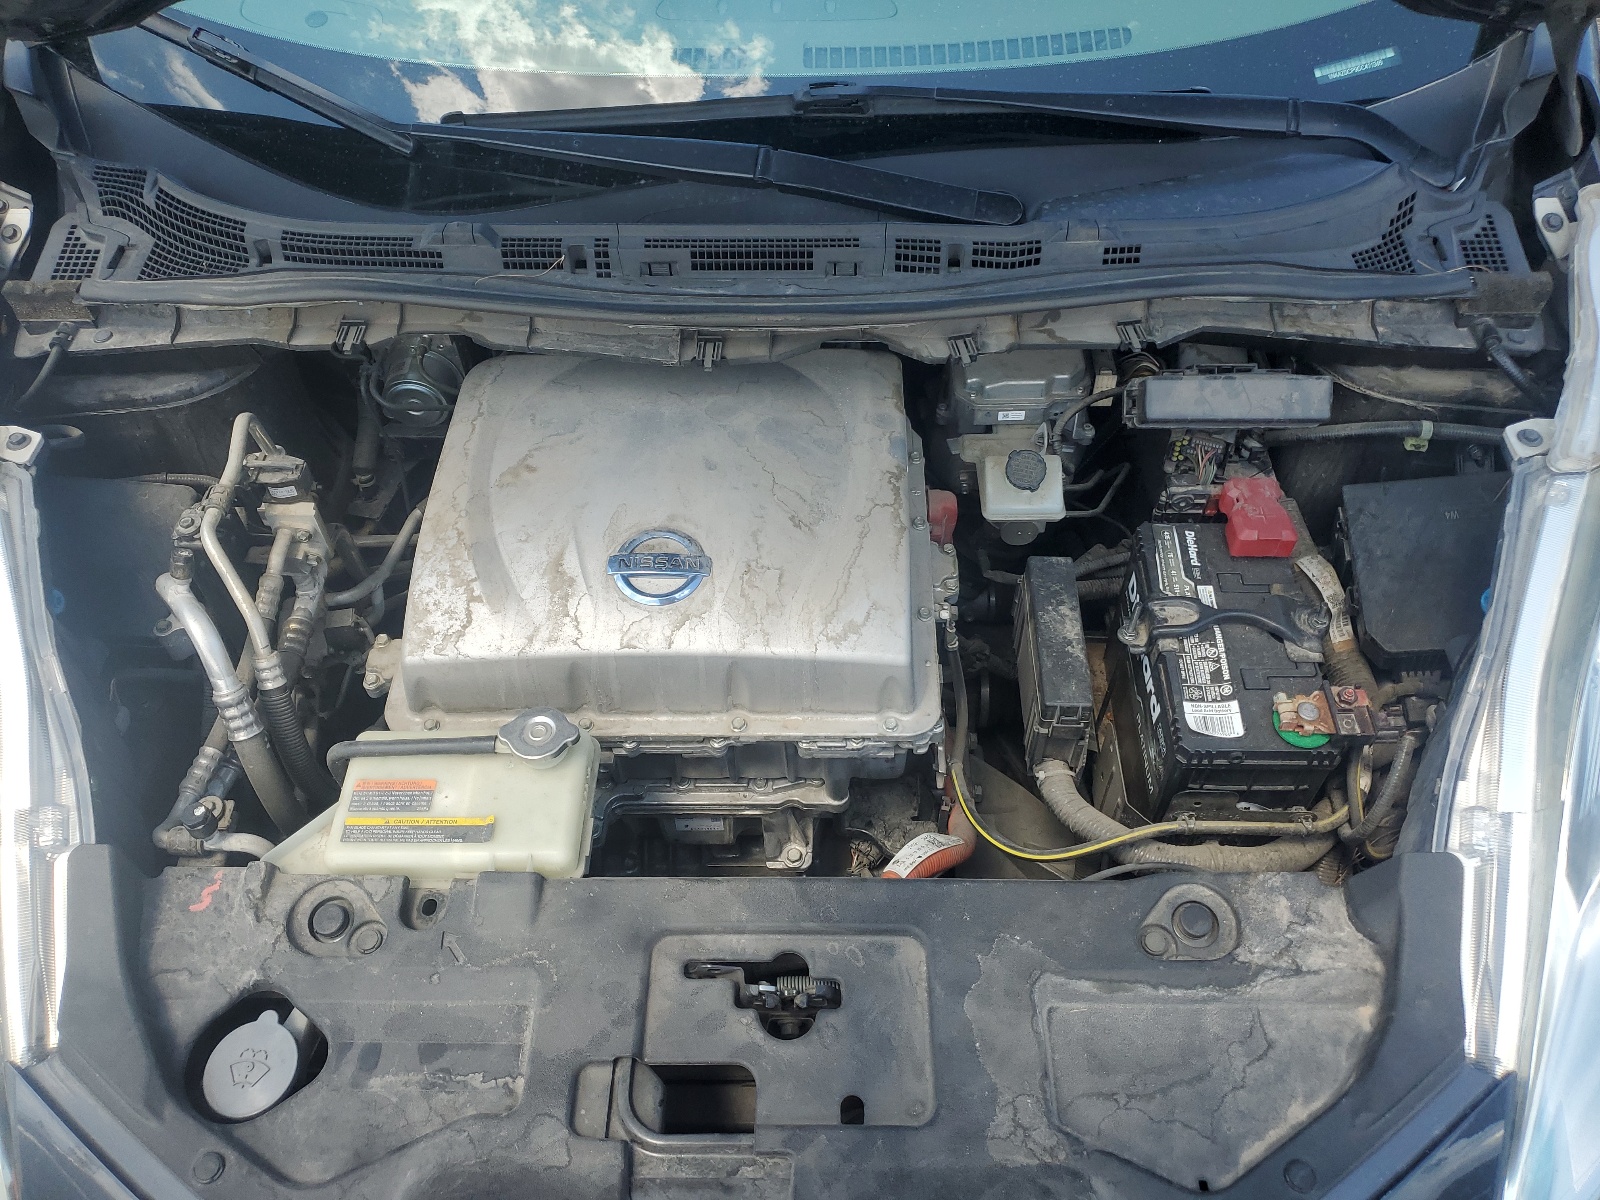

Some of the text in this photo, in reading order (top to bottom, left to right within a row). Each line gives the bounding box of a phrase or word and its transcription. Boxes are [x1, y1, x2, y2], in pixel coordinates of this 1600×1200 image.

[619, 556, 700, 570] NISSAN
[1185, 530, 1201, 566] DieHard
[1213, 627, 1231, 680] DANGER/POISON
